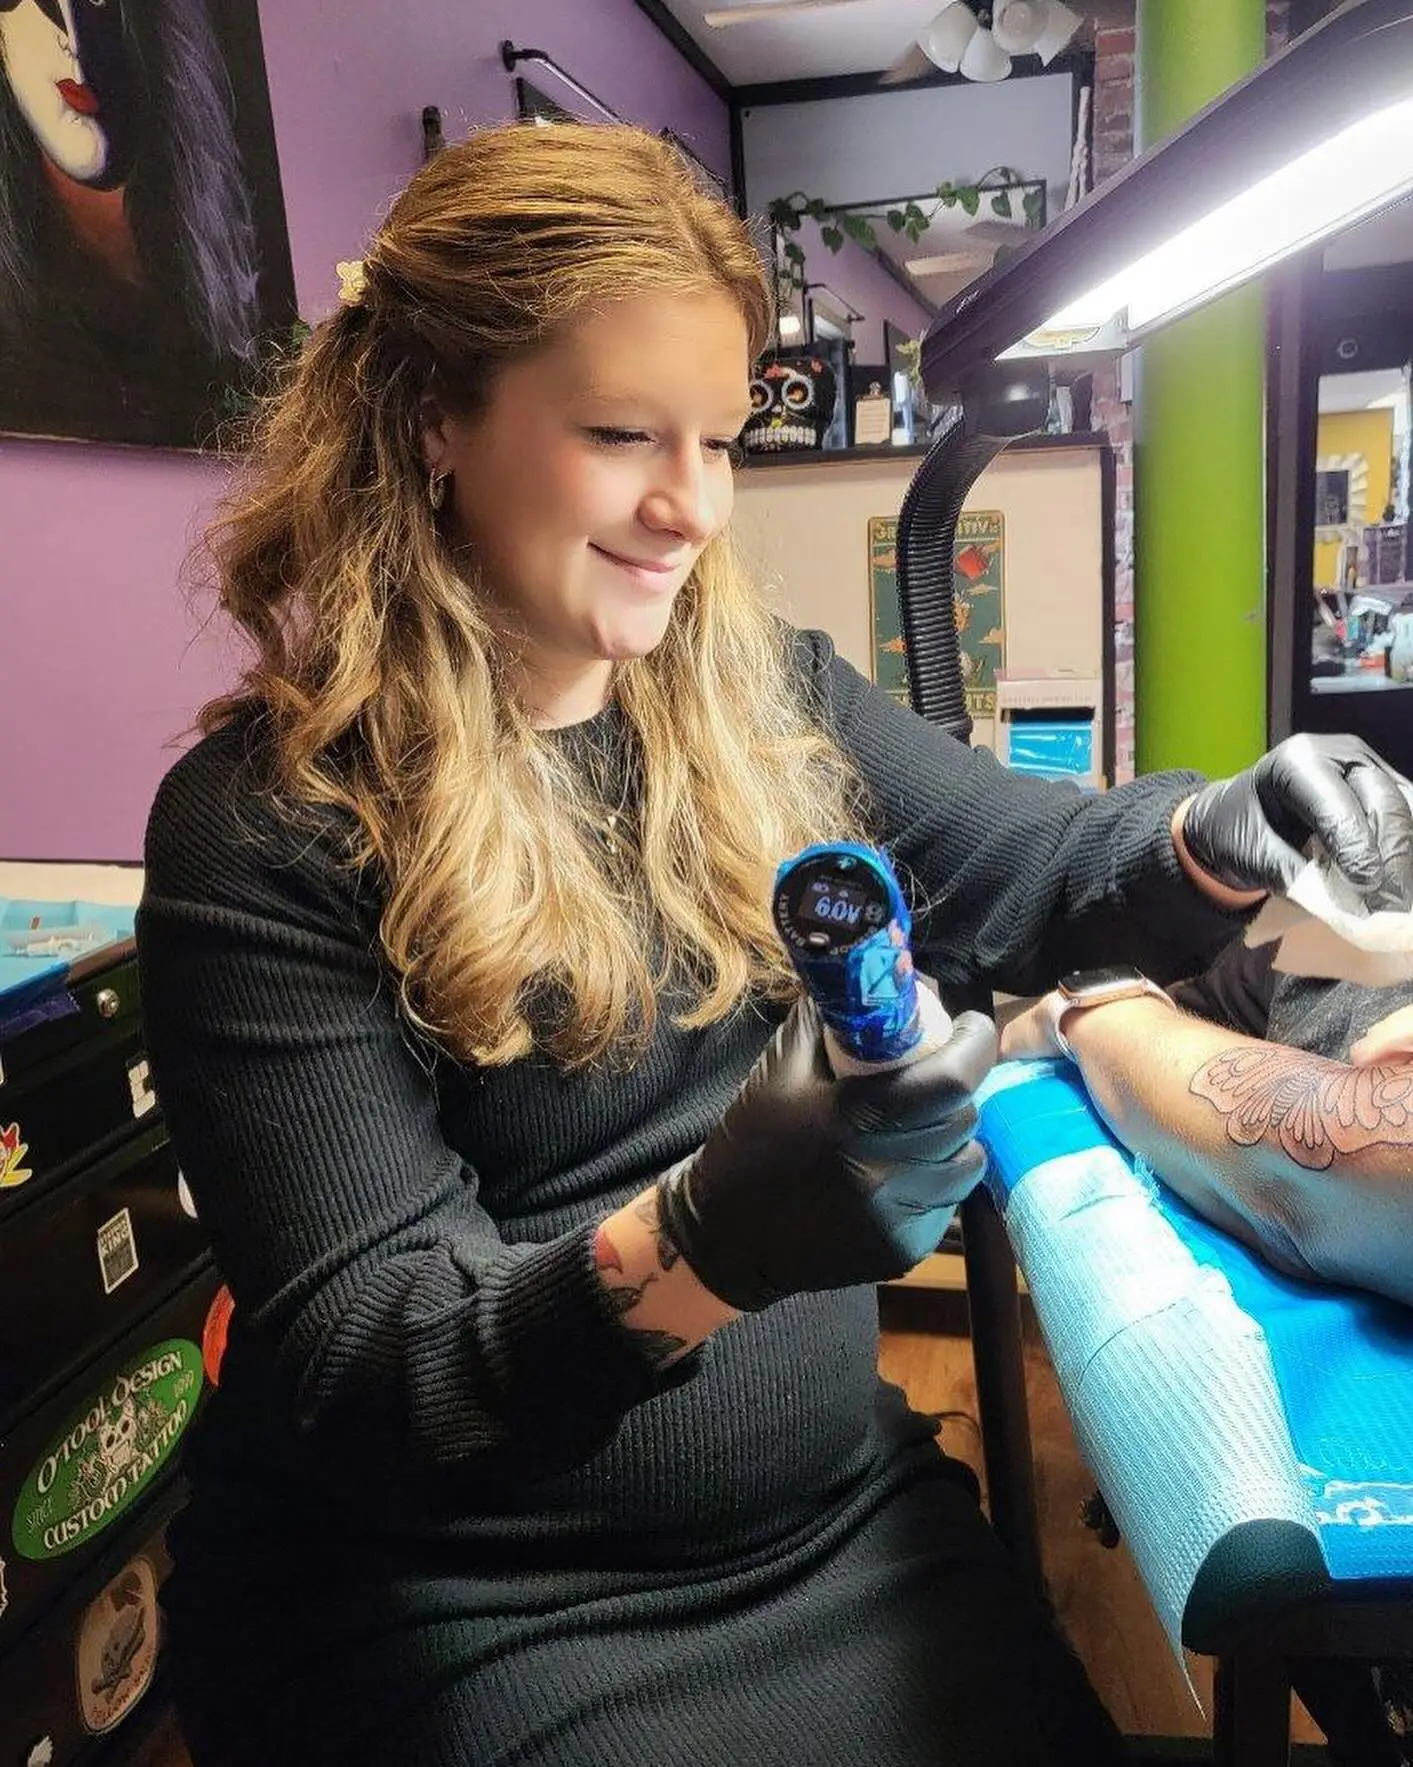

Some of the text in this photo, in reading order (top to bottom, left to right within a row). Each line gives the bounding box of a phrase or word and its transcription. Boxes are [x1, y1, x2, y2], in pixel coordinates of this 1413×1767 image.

[112, 1351, 183, 1406] DESIGN
[44, 1399, 187, 1549] CUSTOM TATTOO
